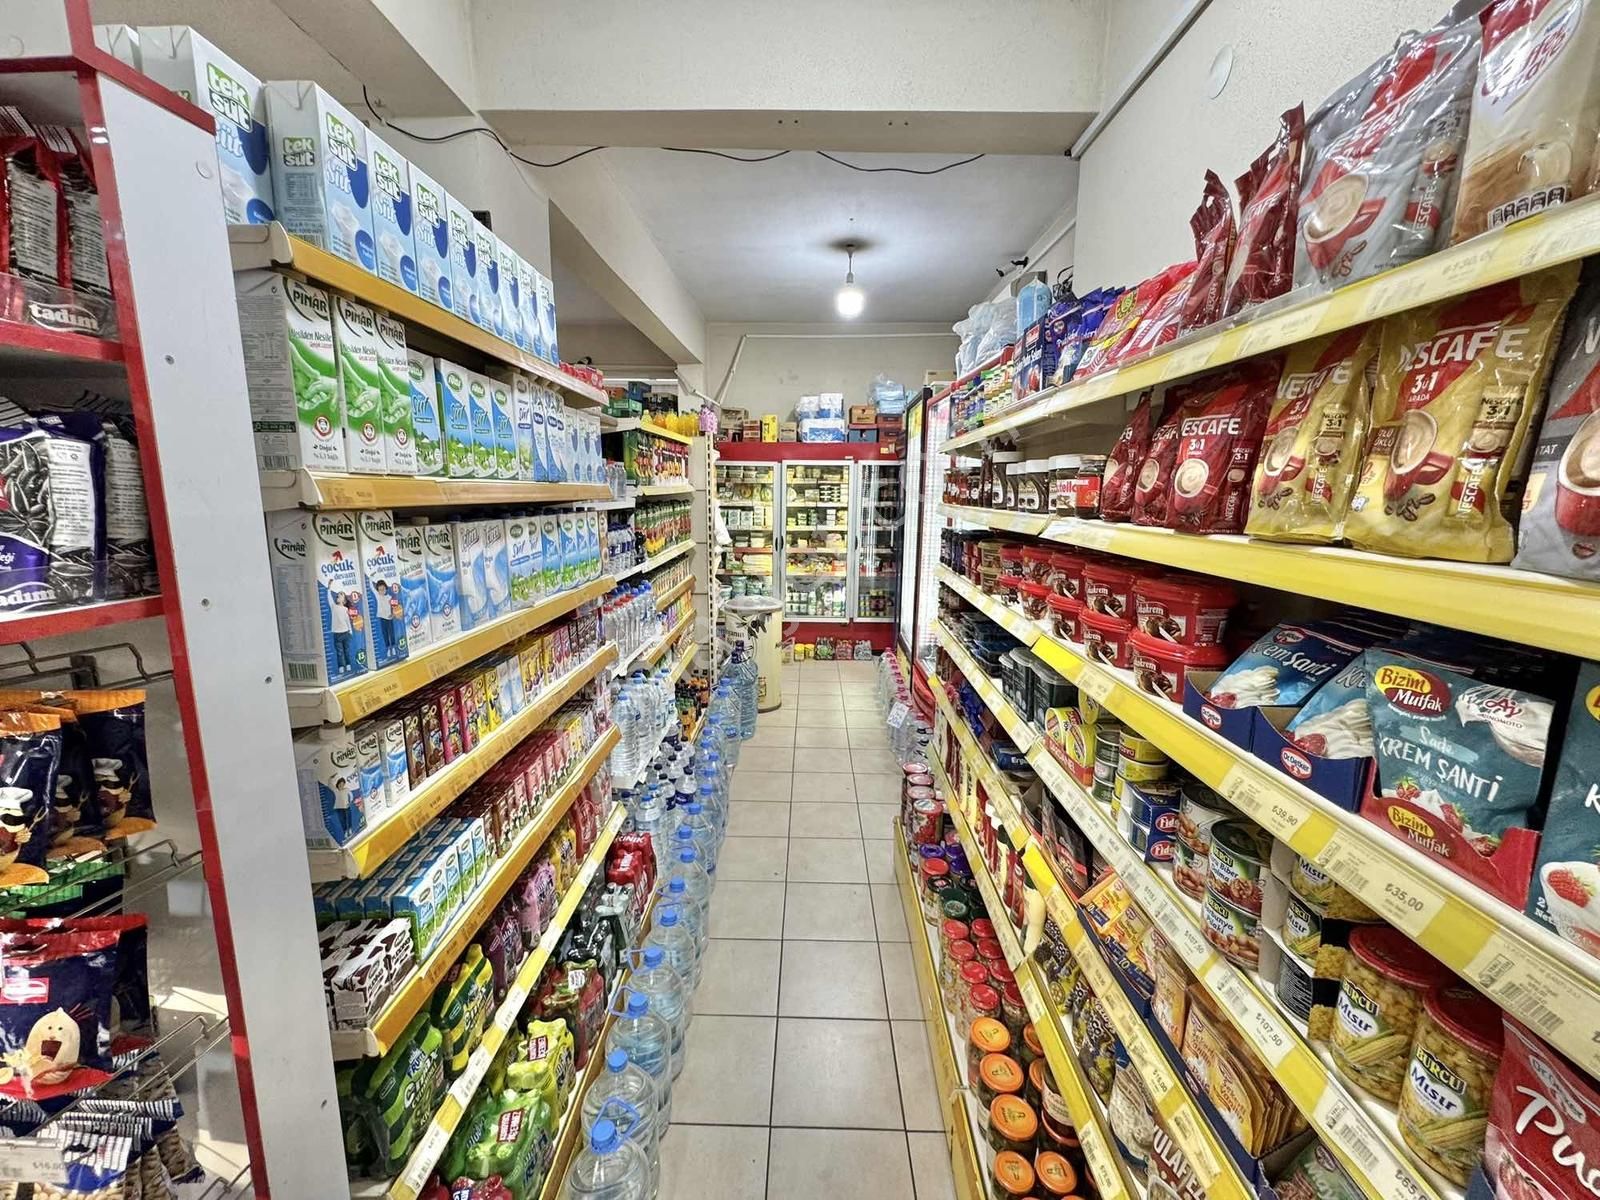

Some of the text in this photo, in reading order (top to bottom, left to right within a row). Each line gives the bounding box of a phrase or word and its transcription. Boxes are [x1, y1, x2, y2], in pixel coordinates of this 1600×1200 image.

[283, 137, 313, 152] tek
[327, 113, 356, 148] tek
[321, 559, 355, 577] çocuk
[366, 554, 396, 571] çocuk
[1380, 667, 1426, 692] Bizim
[1392, 688, 1443, 713] Mutfak
[1379, 733, 1504, 803] KREM ŞANTİ
[1391, 806, 1431, 836] Bizim
[1406, 826, 1451, 858] Mutfak
[1416, 1044, 1467, 1096] BURCU
[1411, 1065, 1458, 1112] Mısır
